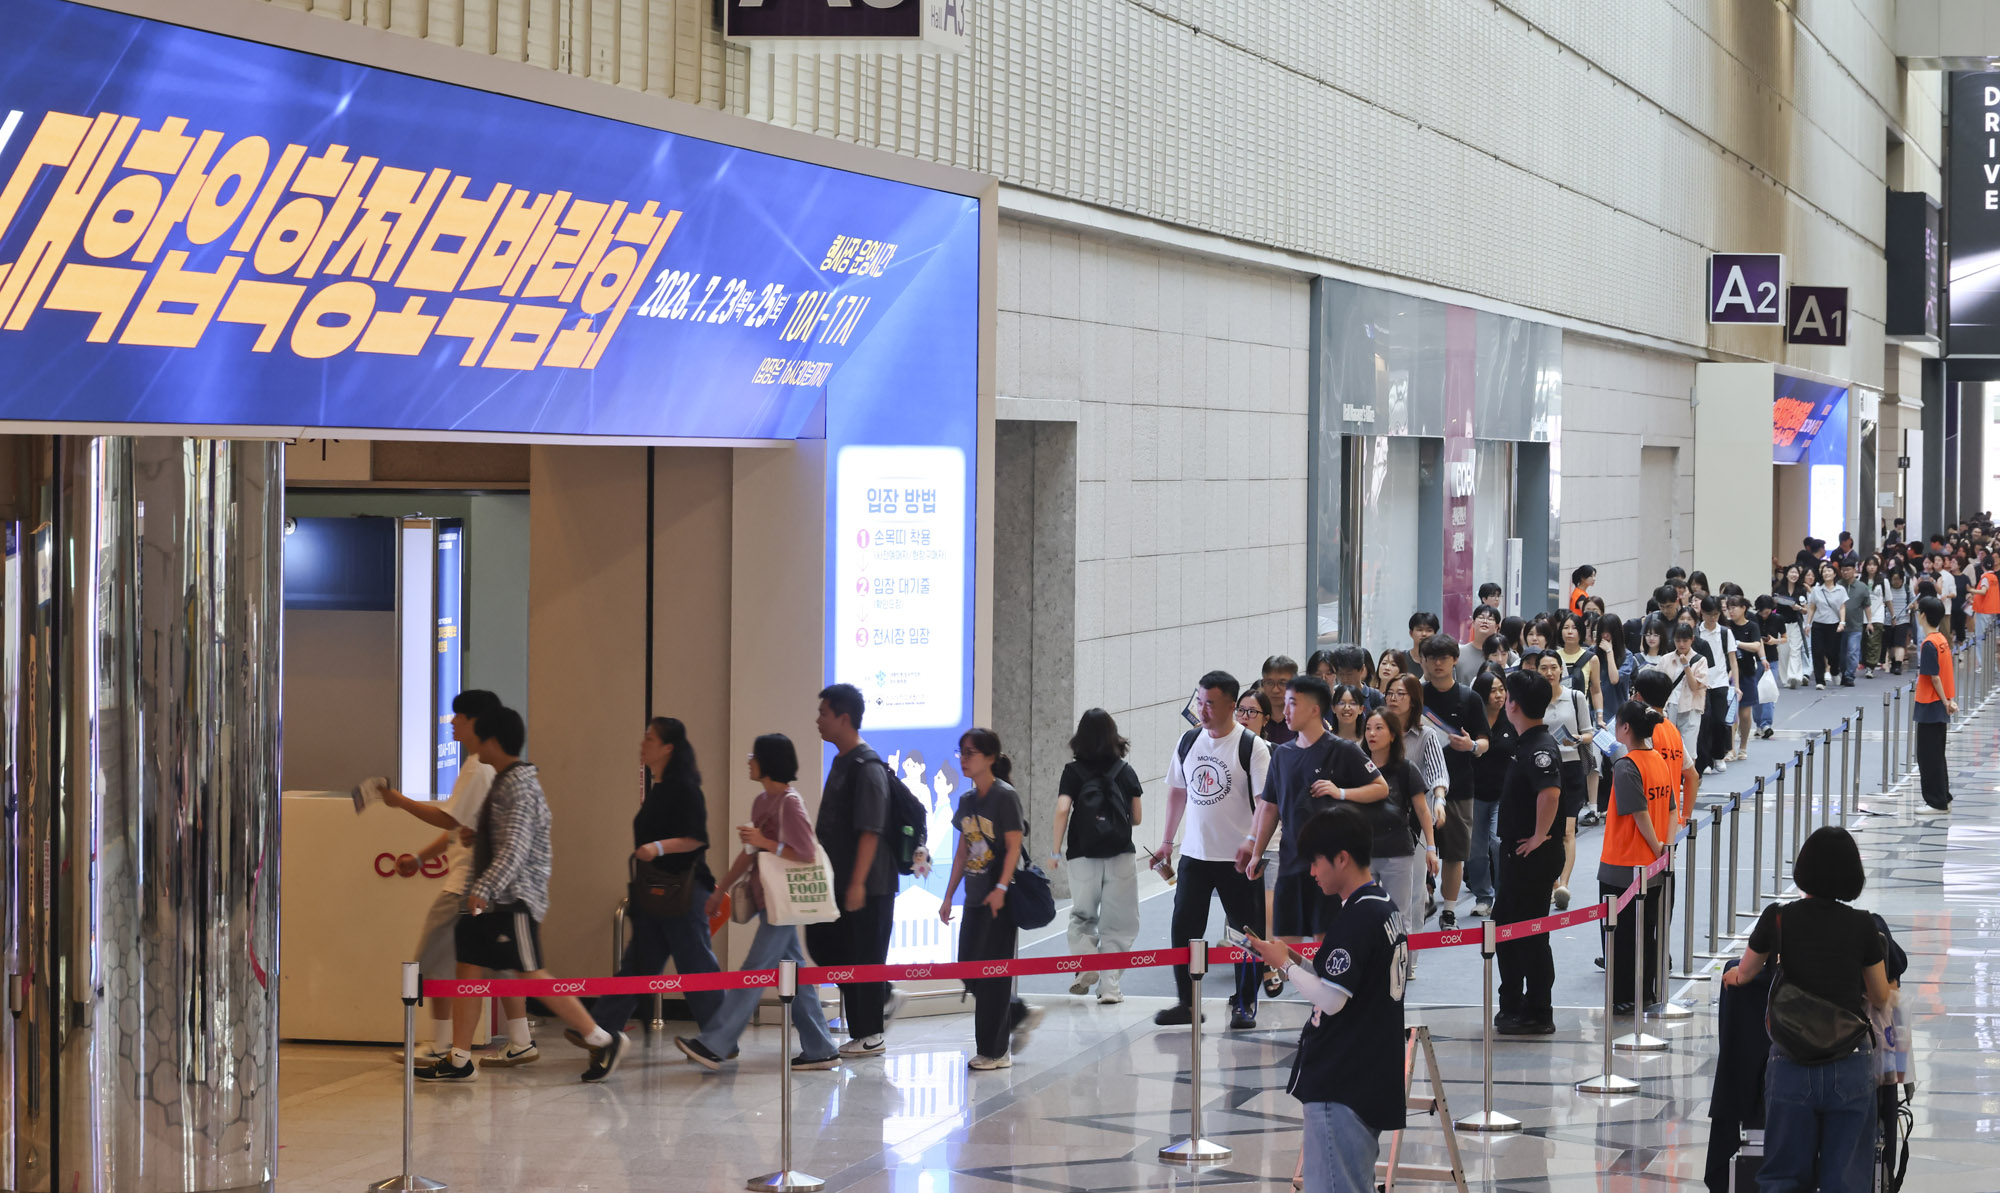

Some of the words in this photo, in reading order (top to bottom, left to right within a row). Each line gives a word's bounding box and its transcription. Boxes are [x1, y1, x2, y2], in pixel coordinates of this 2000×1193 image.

[930, 4, 943, 30] Hall
[944, 0, 965, 37] A3
[1983, 86, 2000, 210] DRIVE
[819, 234, 863, 274] 행사장
[847, 239, 899, 278] 운영시간
[636, 268, 701, 321] 2026.
[690, 275, 722, 323] 7.
[1714, 264, 1777, 314] A2
[779, 290, 871, 347] 10시-17시
[1793, 294, 1842, 338] A1
[867, 488, 899, 514] 입장
[904, 488, 936, 514] 방법
[873, 529, 906, 546] 손목띠
[910, 529, 931, 546] 착용
[873, 577, 895, 595] 입장
[899, 577, 931, 595] 대기줄
[873, 628, 905, 645] 전시장
[909, 627, 930, 645] 입장
[1197, 755, 1228, 770] MONCLER
[1223, 769, 1233, 796] LUXURY
[786, 871, 827, 883] LOCAL
[788, 882, 828, 895] FOOD
[1440, 931, 1463, 945] coex
[1501, 925, 1513, 938] coex
[1056, 956, 1083, 971] coex
[1131, 952, 1157, 967] coex
[827, 967, 855, 982] coex
[905, 965, 933, 979] coex
[982, 962, 1009, 976] coex
[553, 979, 586, 993] coex
[649, 976, 682, 991] coex
[743, 971, 776, 986] coex
[457, 981, 491, 994] coex
